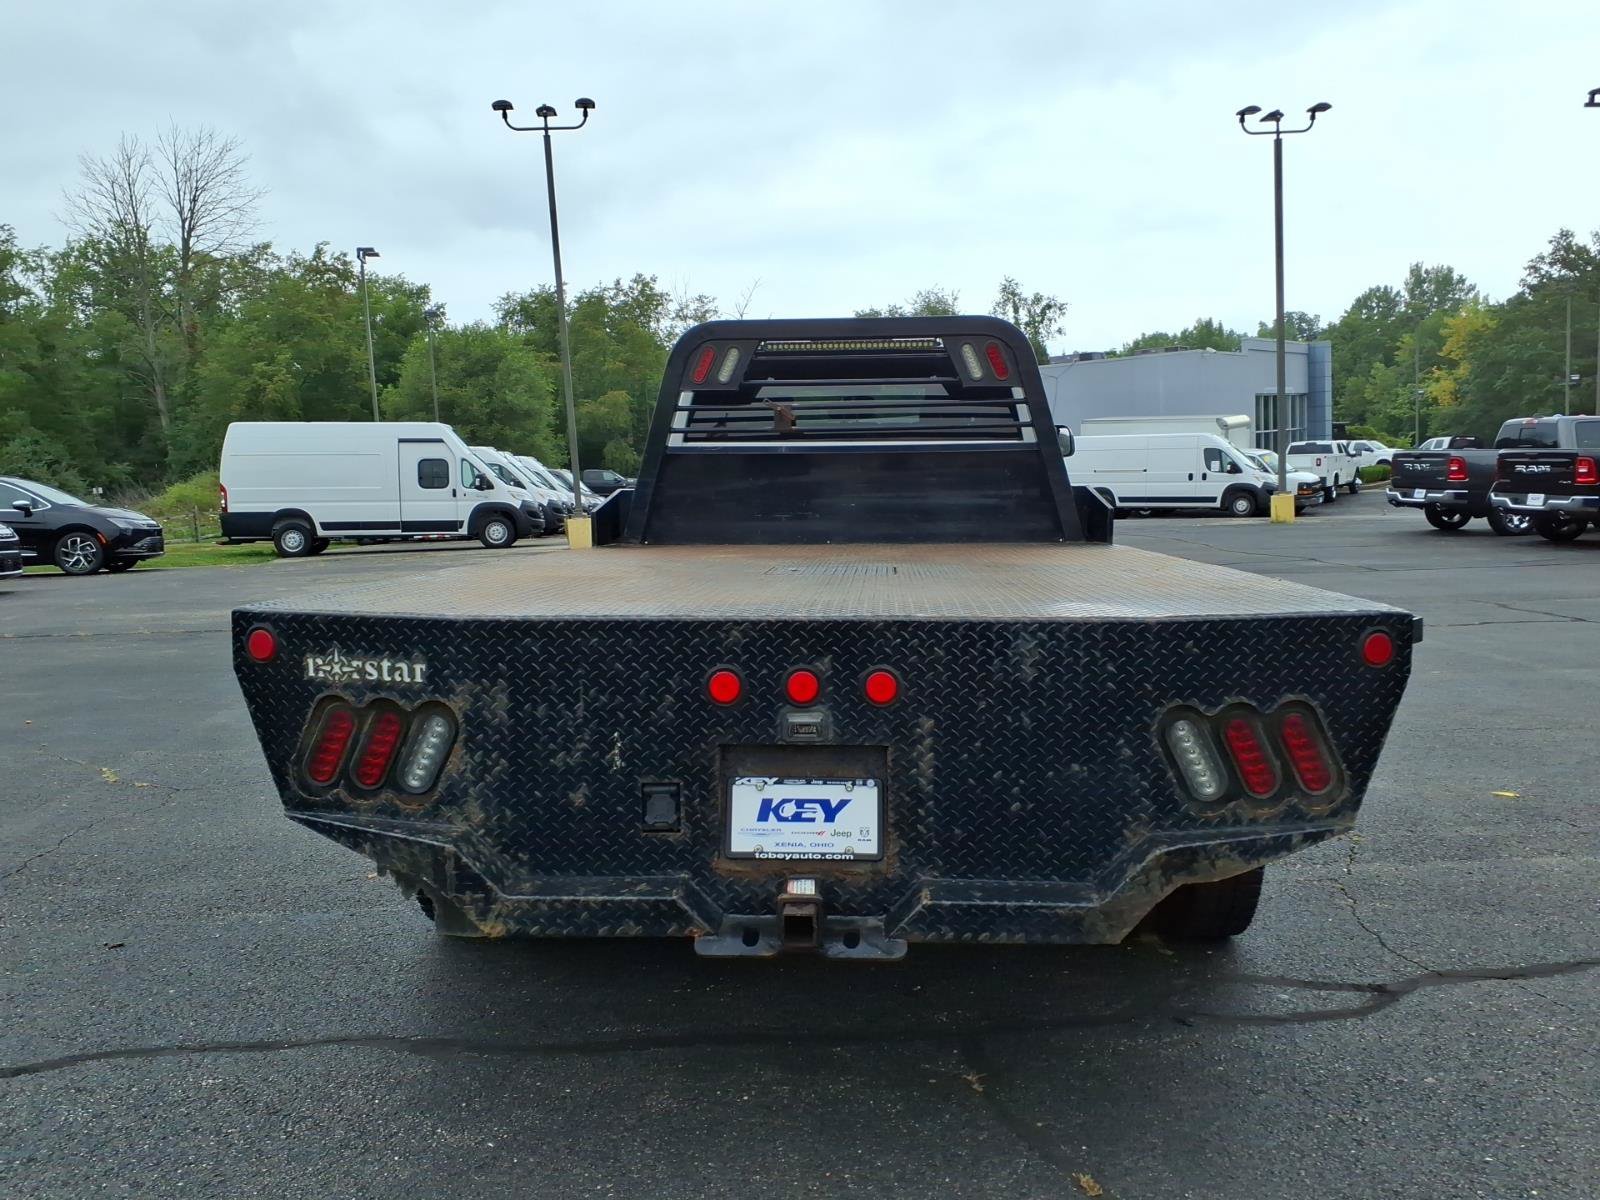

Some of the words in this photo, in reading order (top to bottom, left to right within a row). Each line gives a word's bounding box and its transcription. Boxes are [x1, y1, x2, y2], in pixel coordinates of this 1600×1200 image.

[1514, 464, 1551, 473] RAM
[756, 797, 853, 824] KEY
[830, 829, 852, 838] Jeep
[754, 851, 854, 860] tobeyauto.com
